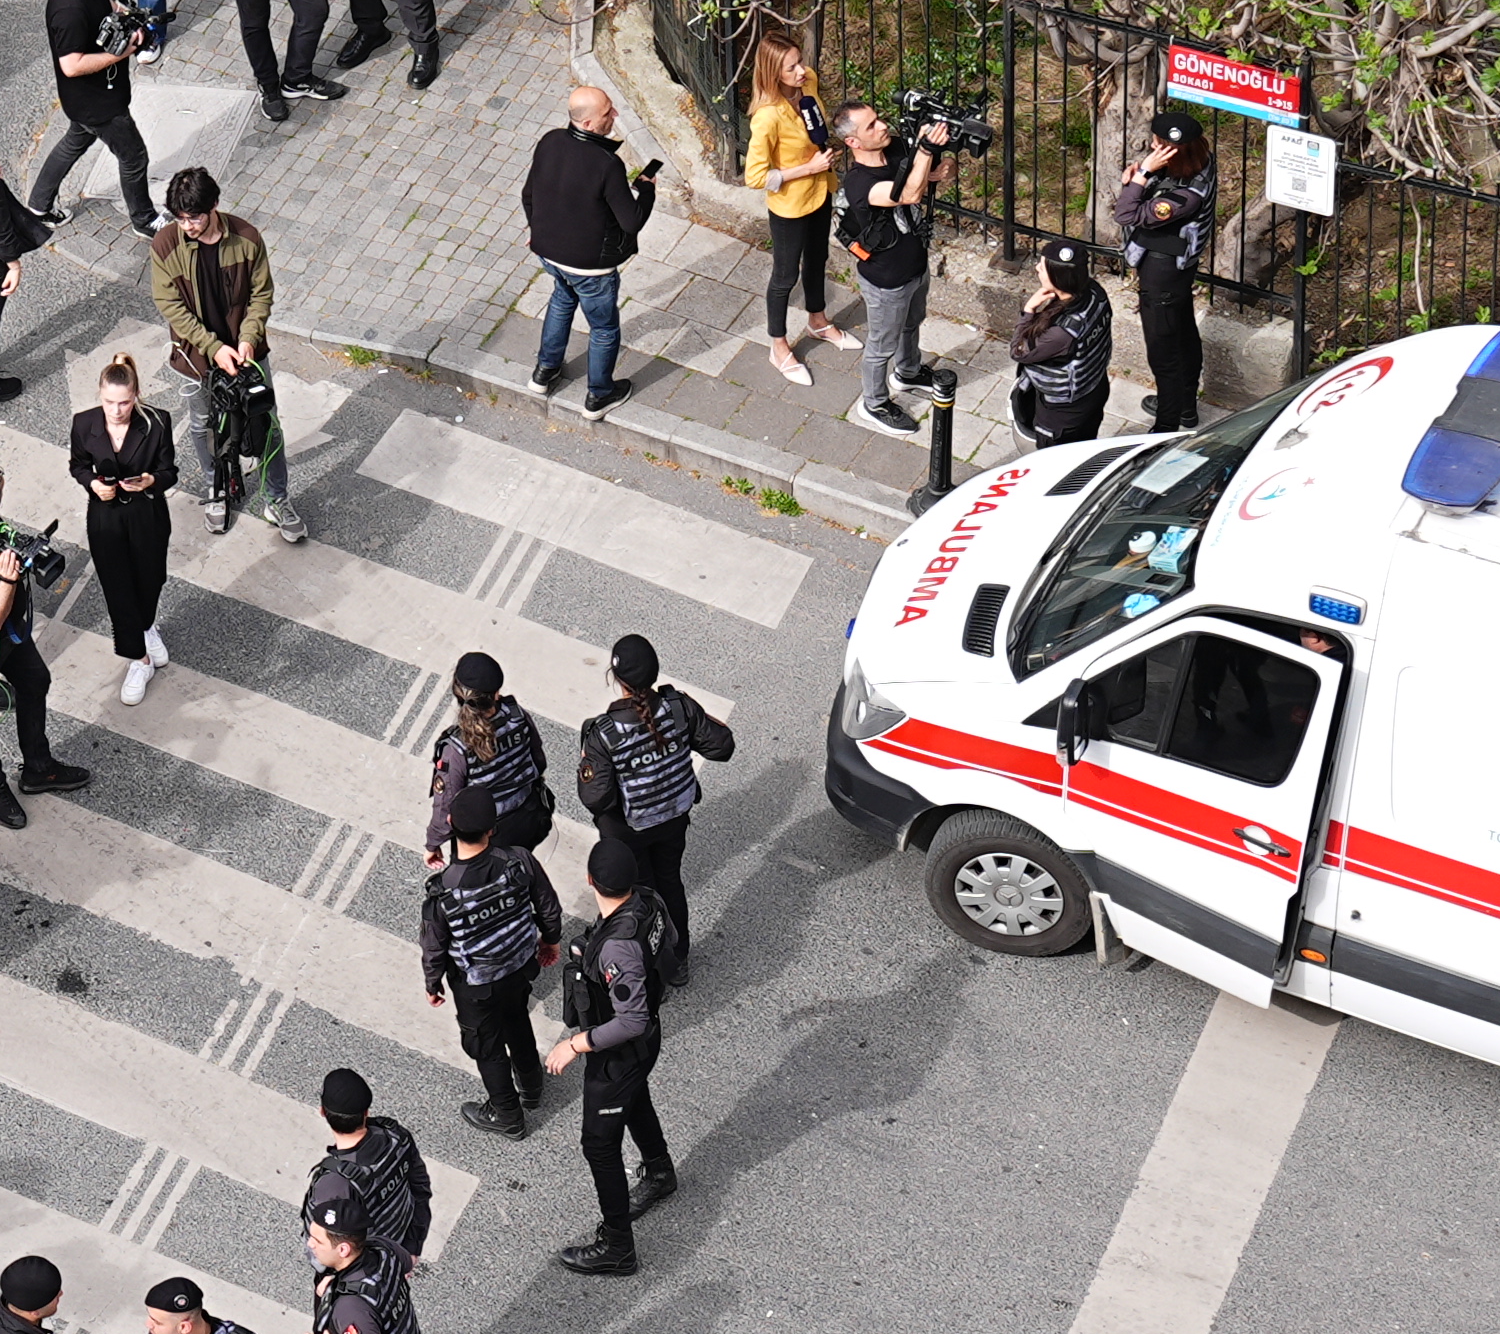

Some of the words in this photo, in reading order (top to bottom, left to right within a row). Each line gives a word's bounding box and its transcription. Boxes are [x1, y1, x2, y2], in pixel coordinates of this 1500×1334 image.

[1172, 71, 1214, 91] SOKAĞI
[1173, 52, 1286, 95] GÖNENOĞLU
[630, 742, 679, 769] POLİS
[468, 896, 516, 927] POLİS
